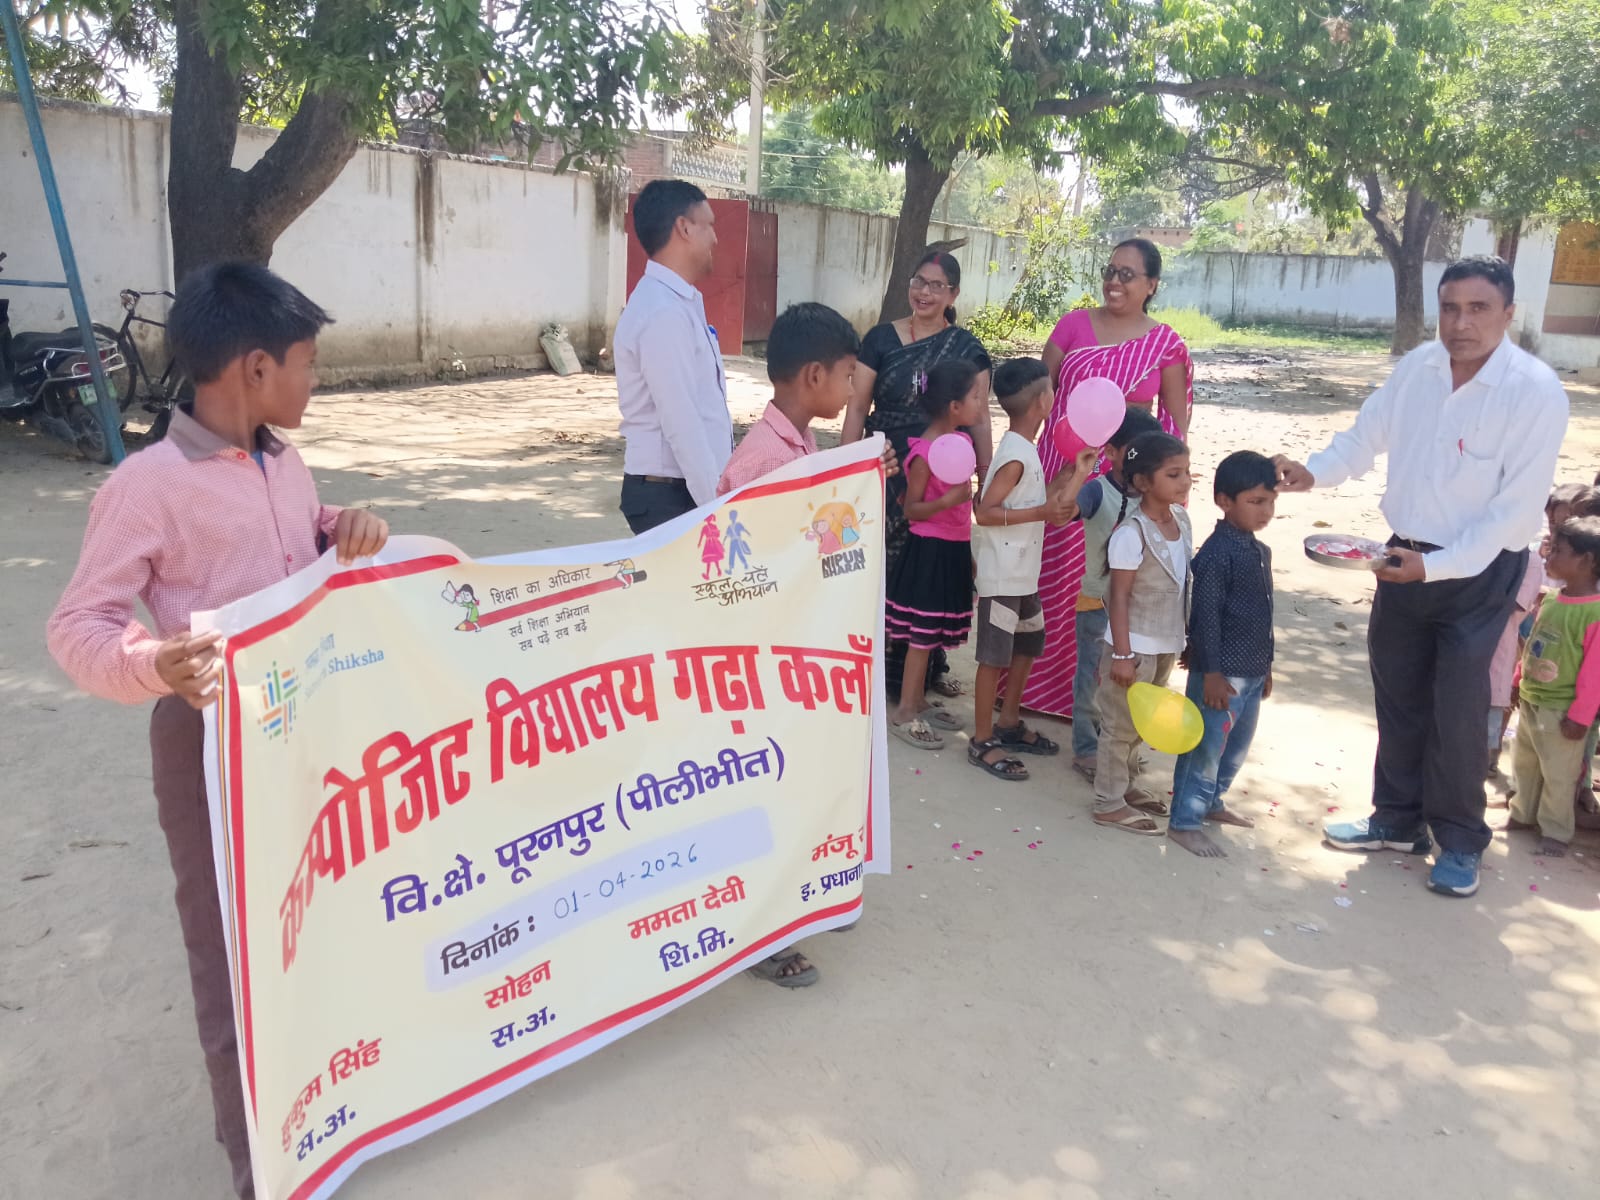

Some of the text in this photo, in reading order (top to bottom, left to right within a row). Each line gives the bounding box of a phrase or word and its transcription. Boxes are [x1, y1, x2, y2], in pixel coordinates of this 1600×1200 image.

[821, 548, 866, 569] NIPUN
[490, 567, 592, 605] शिक्षा का अधिकार
[719, 581, 779, 606] अभियान
[508, 604, 590, 638] सर्व शिक्षा अभियान
[519, 639, 533, 651] सब
[555, 628, 569, 640] सब
[328, 648, 385, 674] Shiksha
[485, 653, 659, 783] विद्यालय
[666, 645, 765, 734] गढ़ा
[380, 736, 785, 922] वि.क्षे. पूरनपुर (पीलीभीत)
[812, 834, 859, 862] मंजू
[554, 843, 697, 919] 01-04-2026
[820, 861, 864, 895] प्रधाना
[627, 876, 746, 940] ममता देवी
[659, 926, 735, 973] शि.मि.
[484, 960, 552, 1009] सोहन
[490, 1006, 557, 1048] स.अ.
[328, 1037, 383, 1086] सिंह
[296, 1104, 357, 1161] स.अ.
